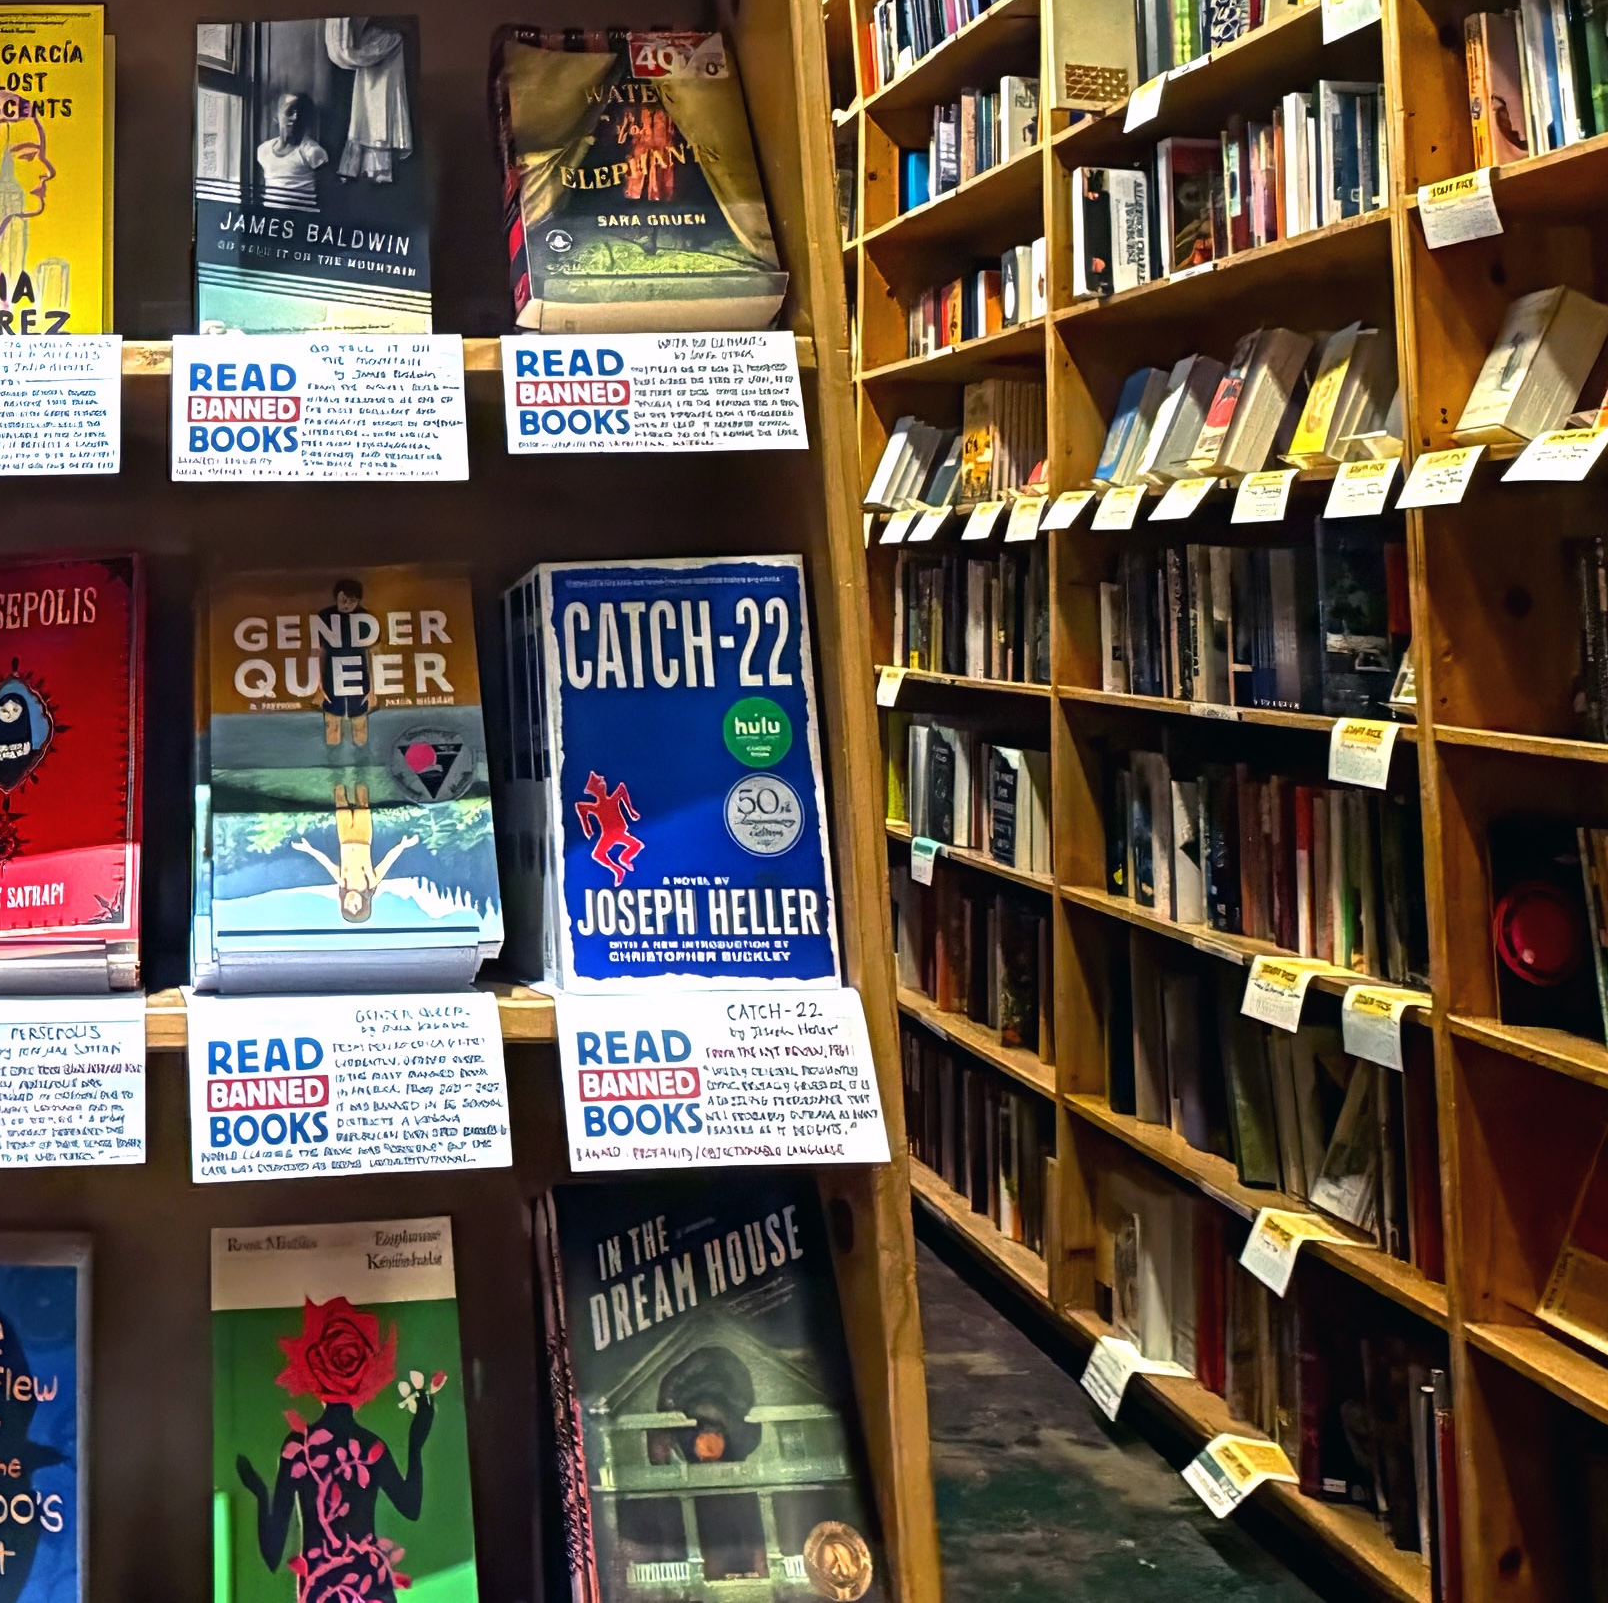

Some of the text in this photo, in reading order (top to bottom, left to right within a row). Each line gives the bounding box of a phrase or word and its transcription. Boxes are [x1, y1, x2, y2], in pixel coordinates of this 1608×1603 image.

[220, 211, 410, 256] JAMES BALDWIN
[597, 214, 641, 227] SARA
[190, 363, 296, 392] READ
[516, 349, 624, 377] READ
[519, 382, 628, 404] BANNED
[189, 398, 297, 421] BANNED
[519, 409, 630, 435] BOOKS
[189, 425, 299, 454] BOOKS
[233, 610, 453, 652] GENDER
[562, 597, 793, 690] CATCH-22
[234, 652, 455, 698] QUEER
[735, 715, 780, 735] hulu
[674, 876, 710, 886] NOVEL
[577, 888, 821, 936] JOSEPH HELLER
[208, 1037, 325, 1074] READ
[577, 1030, 692, 1065] READ
[209, 1079, 326, 1107] BANNED
[581, 1071, 697, 1097] BANNED
[209, 1112, 328, 1148] BOOKS
[584, 1104, 702, 1137] BOOKS
[597, 1215, 670, 1281] IN THE
[590, 1204, 804, 1351] DREAM HOUSE
